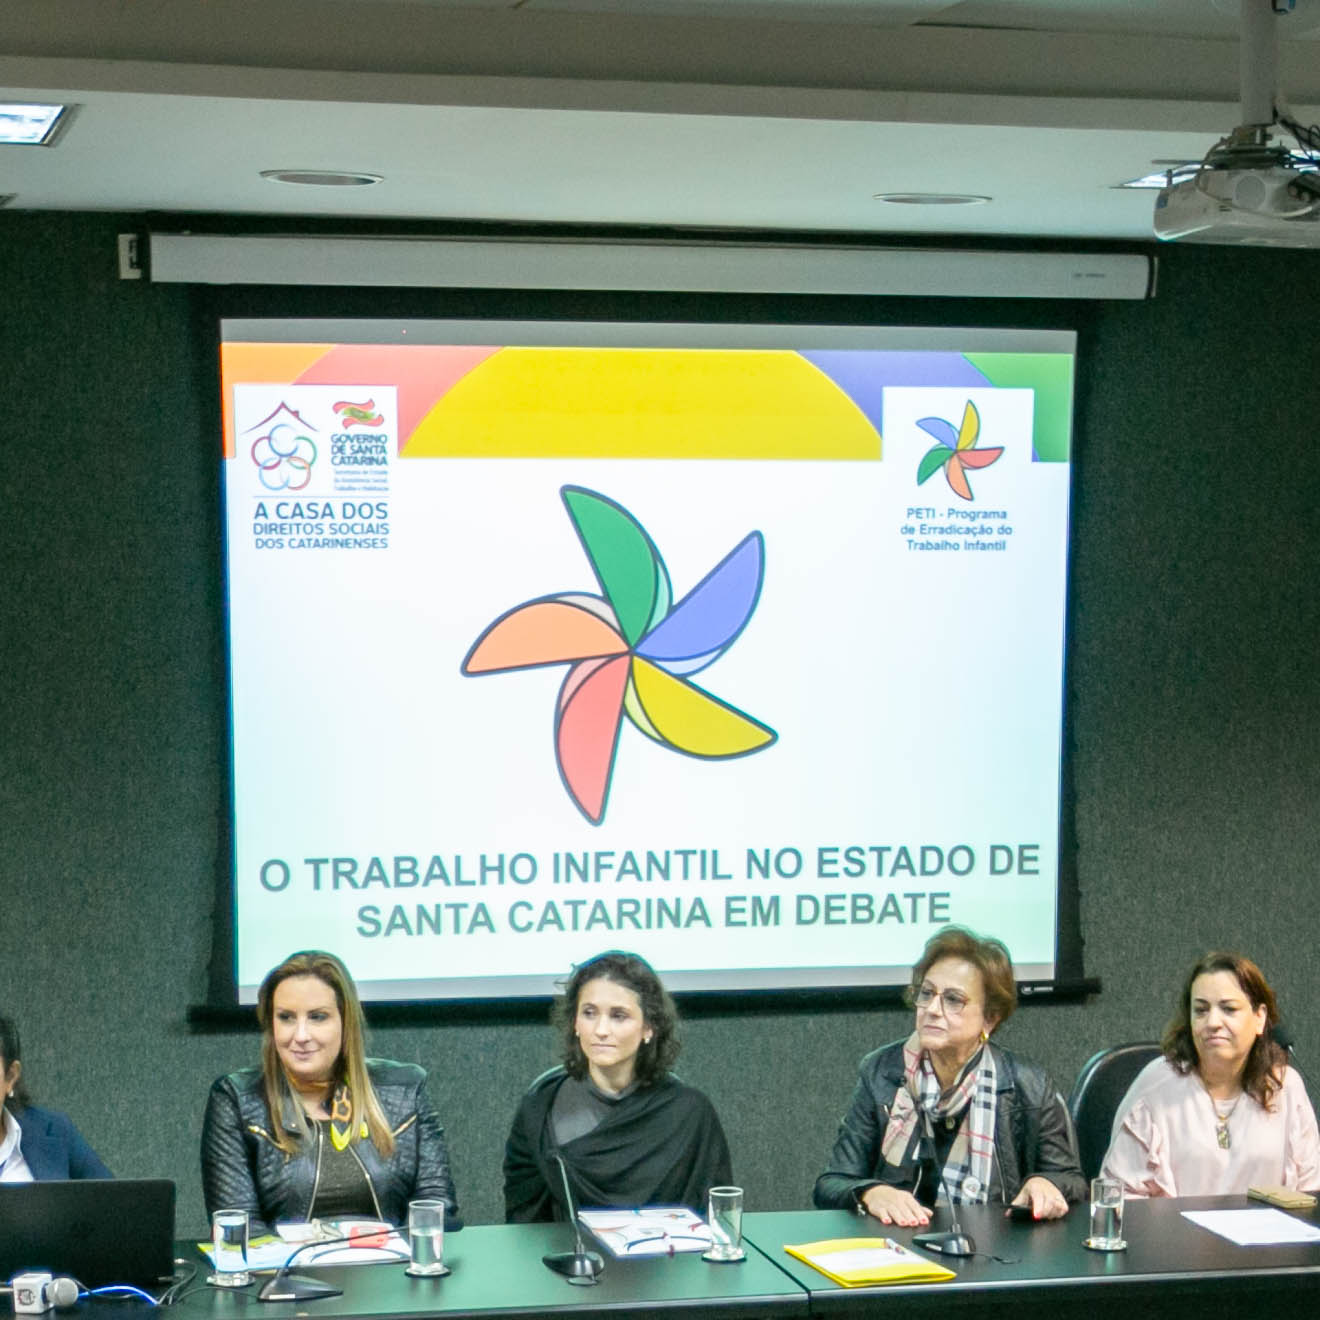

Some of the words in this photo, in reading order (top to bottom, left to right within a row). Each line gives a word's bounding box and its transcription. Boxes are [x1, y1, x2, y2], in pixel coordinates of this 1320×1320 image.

[330, 434, 388, 444] GOVERNO
[331, 445, 347, 455] DE
[350, 445, 388, 455] SANTA
[330, 456, 388, 466] CATARINA
[254, 502, 268, 520] A
[275, 502, 335, 520] CASA
[342, 502, 388, 520] DOS
[906, 508, 936, 519] PETI
[947, 508, 1008, 522] Programa
[253, 522, 325, 536] DIREITOS
[329, 522, 390, 536] SOCIAIS
[900, 524, 915, 535] de
[919, 524, 993, 538] Erradicação
[997, 524, 1013, 535] do
[255, 538, 284, 549] DOS
[288, 538, 388, 549] CATARINENSES
[906, 539, 960, 551] Trabalho
[964, 539, 1006, 551] Infantil
[259, 858, 291, 892] O
[304, 853, 538, 891] TRABALHO
[552, 849, 733, 884] INFANTIL
[746, 847, 803, 880] NO
[816, 845, 976, 878] ESTADO
[988, 844, 1040, 876] DE
[356, 902, 496, 938] SANTA
[508, 897, 712, 933] CATARINA
[724, 895, 781, 928] EM
[795, 892, 951, 925] DEBATE
